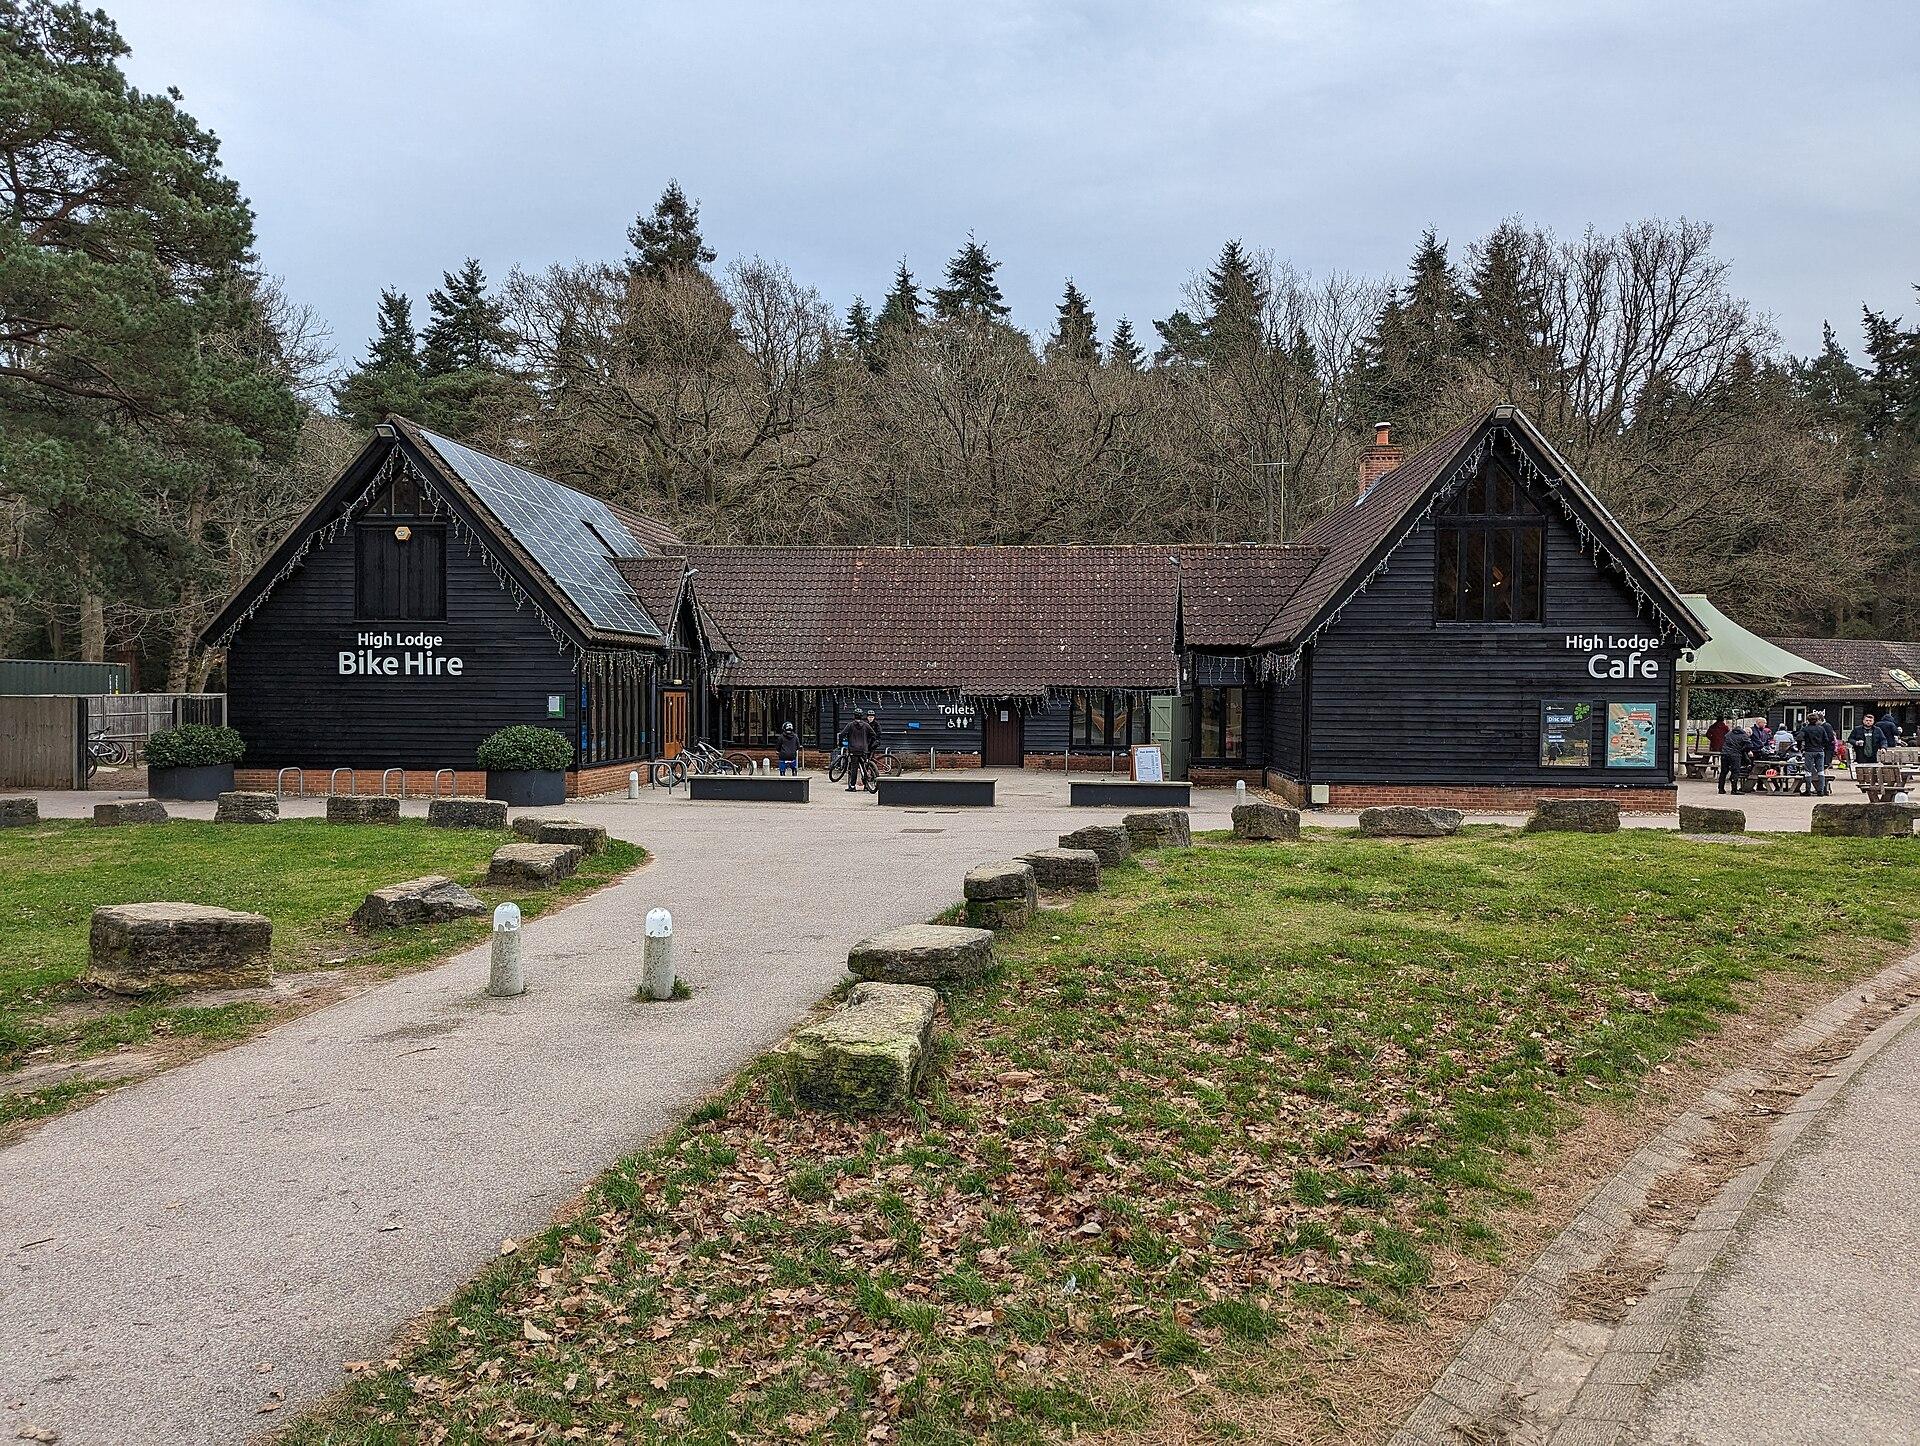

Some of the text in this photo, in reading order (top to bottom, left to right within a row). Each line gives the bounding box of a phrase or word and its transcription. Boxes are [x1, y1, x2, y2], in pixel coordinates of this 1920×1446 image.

[358, 632, 442, 648] High Lodge
[1566, 634, 1659, 651] High Lodge
[339, 650, 464, 675] Bike Hire
[1588, 652, 1659, 678] Cafe
[938, 704, 975, 715] Toilets
